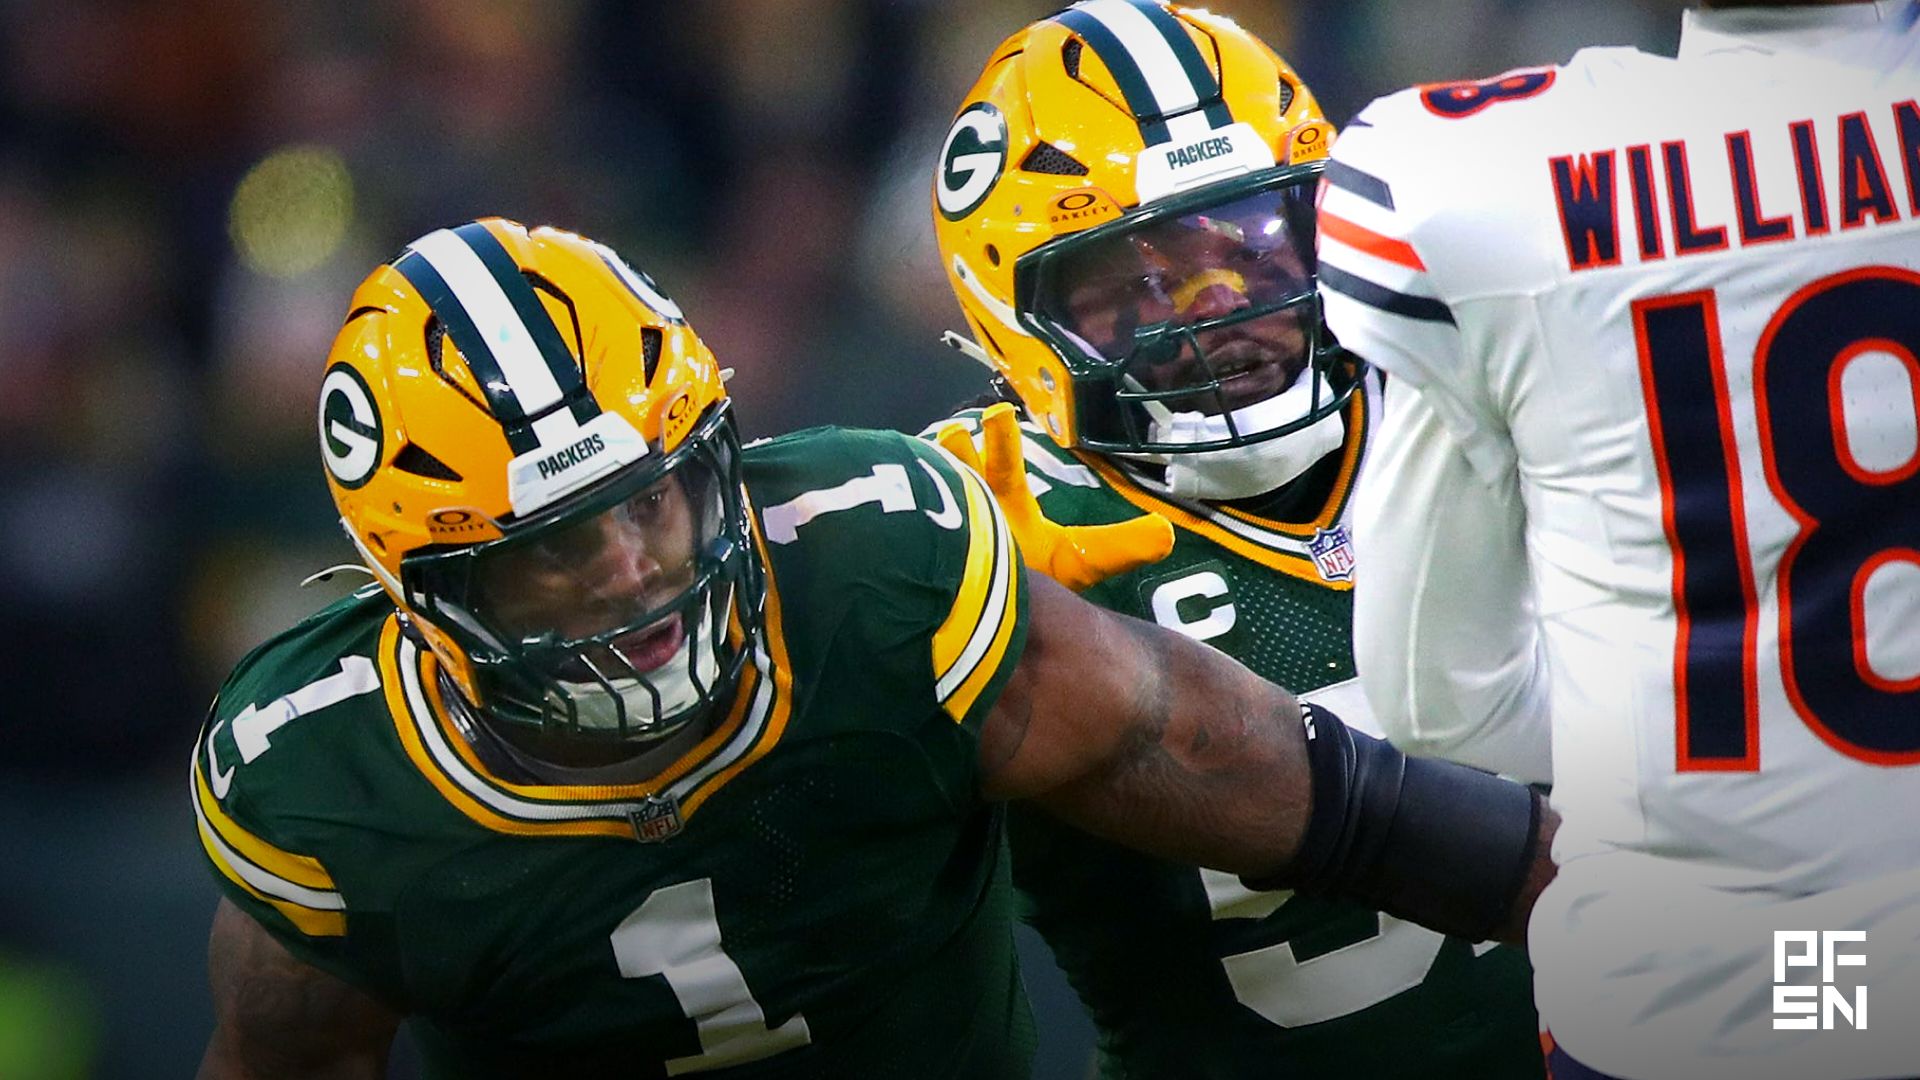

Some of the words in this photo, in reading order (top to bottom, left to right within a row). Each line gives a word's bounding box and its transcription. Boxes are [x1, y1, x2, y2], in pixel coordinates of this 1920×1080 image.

[1166, 136, 1233, 170] PACKERS
[1548, 99, 1920, 272] WILLIA
[1051, 205, 1109, 223] OAKLEY
[537, 433, 605, 480] PACKERS
[762, 464, 917, 545] 1
[1630, 264, 1920, 772] 18
[1320, 546, 1354, 574] NFL
[1151, 571, 1237, 640] C
[232, 654, 381, 764] 1
[641, 816, 678, 839] NFL
[610, 878, 812, 1077] 1
